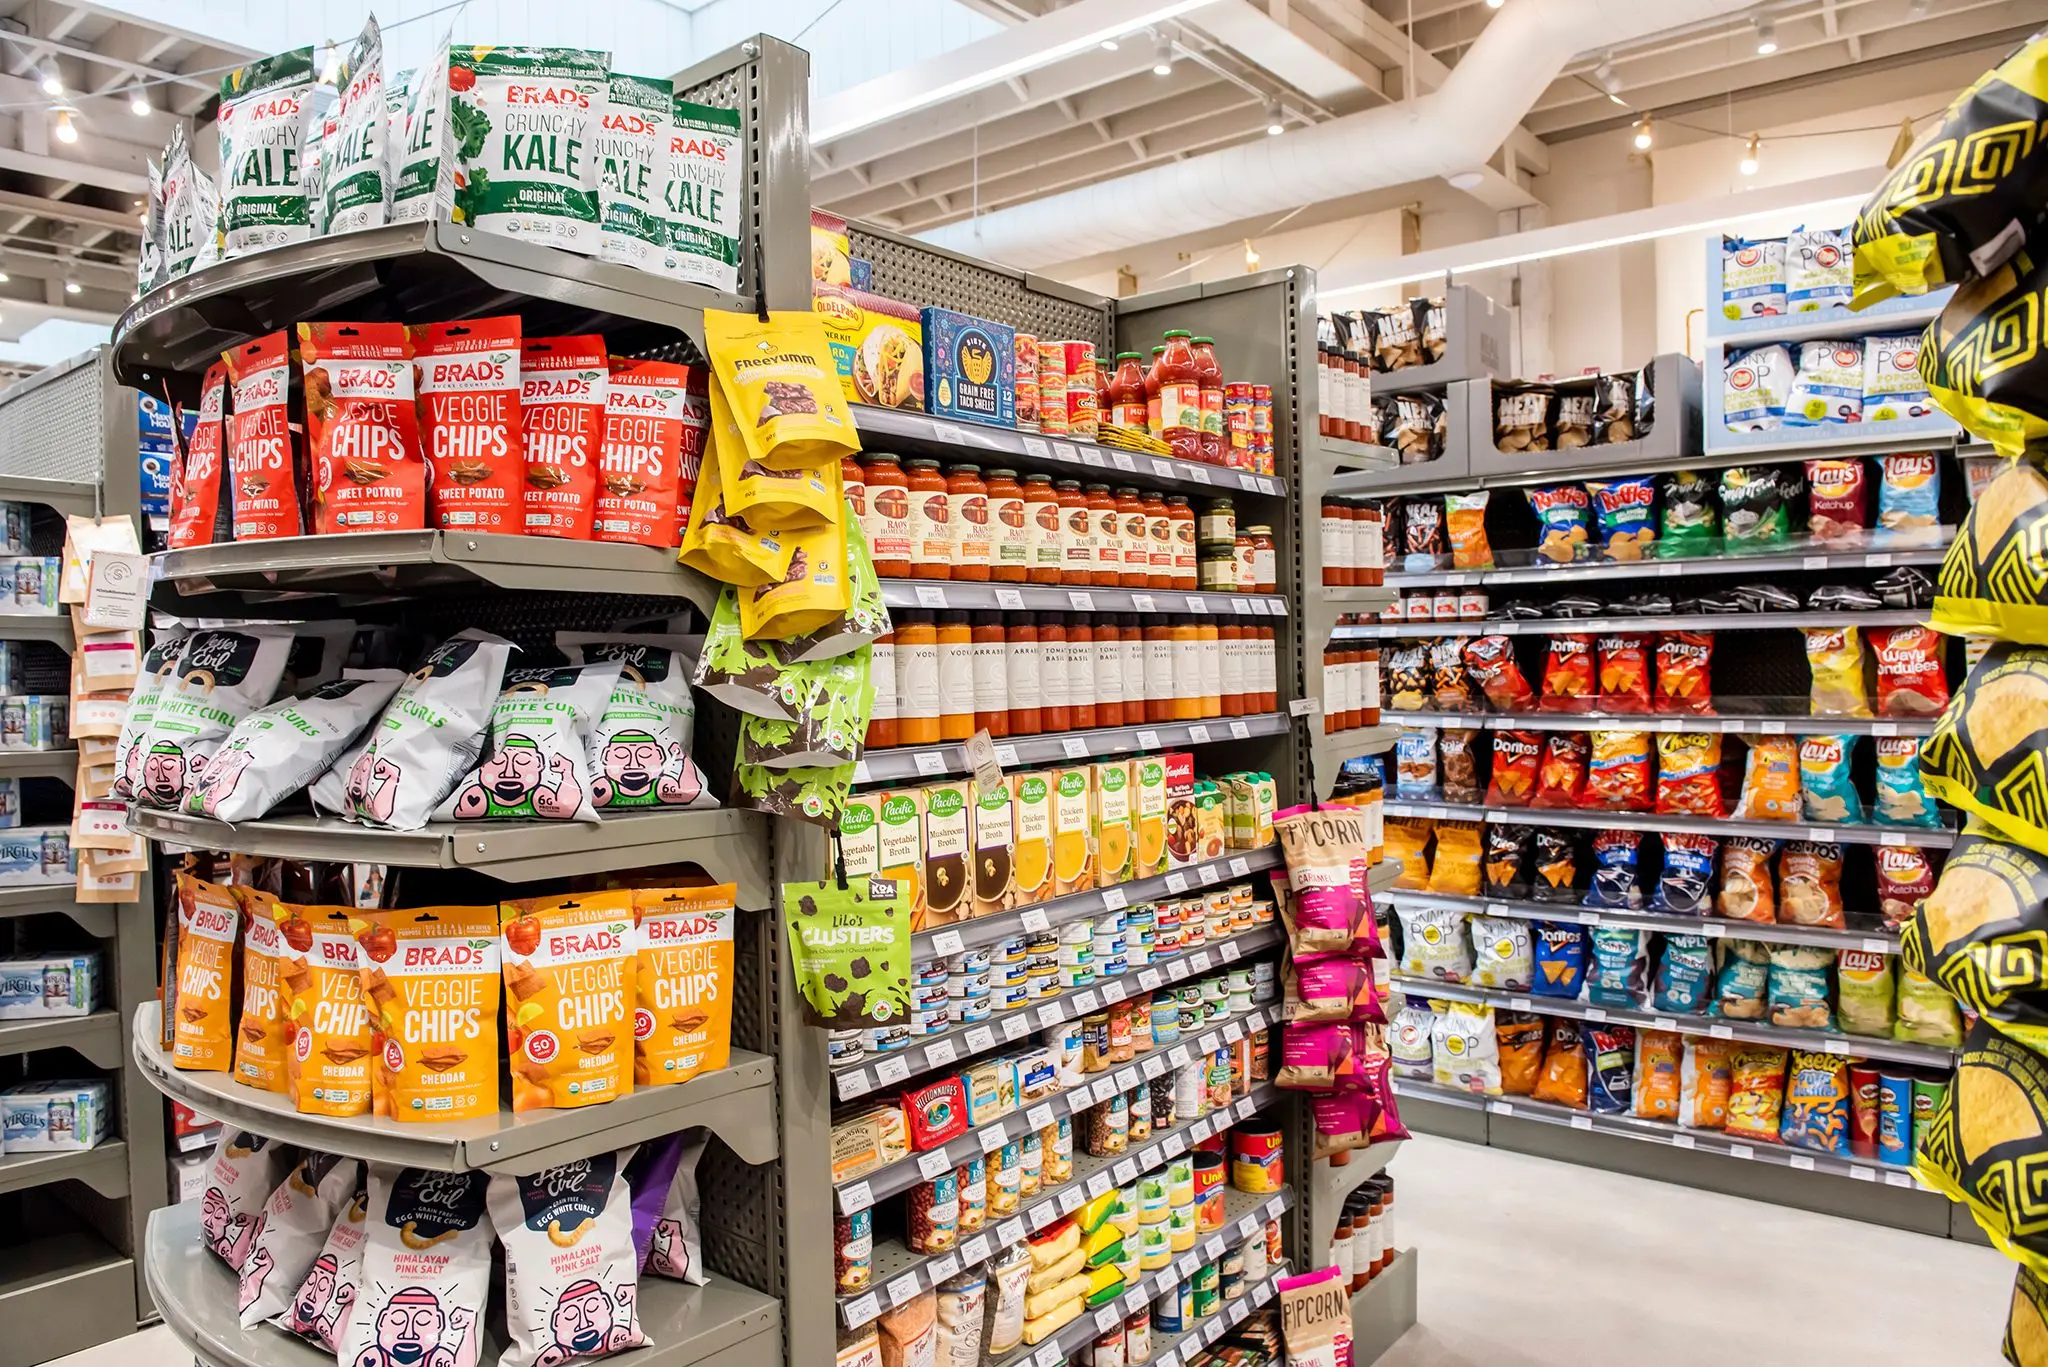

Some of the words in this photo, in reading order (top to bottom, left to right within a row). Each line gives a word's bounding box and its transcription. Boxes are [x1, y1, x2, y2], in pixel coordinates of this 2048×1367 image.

[504, 113, 587, 137] CRUNCHY
[504, 134, 582, 180] KALE
[519, 189, 566, 204] ORIGINAL
[236, 202, 279, 216] ORIGINAL
[959, 383, 979, 396] GRAIN
[980, 386, 995, 399] FREE
[1002, 390, 1013, 401] 12
[433, 396, 507, 422] VEGGIE
[959, 396, 975, 408] TACO
[975, 399, 995, 412] SHELLS
[241, 409, 283, 438] VEGGIE
[331, 425, 405, 460] CHIPS
[432, 425, 508, 459] CHIPS
[236, 438, 283, 473] CHIPS
[1888, 455, 1935, 478] Lay's
[337, 487, 364, 500] SWEET
[366, 486, 403, 498] POTATO
[438, 488, 465, 500] SWEET
[468, 487, 505, 499] POTATO
[546, 492, 581, 504] POTATO
[1533, 486, 1589, 511] Ruffles
[1600, 483, 1654, 511] Ruffles
[253, 498, 280, 511] POTATO
[627, 499, 657, 513] POTATO
[1815, 500, 1854, 511] Ketchup
[608, 647, 646, 668] Evil
[1882, 650, 1926, 663] Wavy
[403, 700, 448, 728] CURLS
[649, 701, 694, 717] CURLS
[200, 707, 237, 728] CURL
[1493, 738, 1539, 756] Doritos
[1060, 776, 1084, 791] Pacific
[1102, 771, 1125, 786] Pacific
[662, 784, 677, 794] 6G
[1022, 782, 1046, 797] Pacific
[538, 796, 554, 806] 6G
[931, 794, 961, 809] Pacific
[1104, 799, 1125, 809] Chicken
[884, 802, 914, 817] Pacific
[1060, 807, 1084, 817] Chicken
[840, 811, 872, 826] Pacific
[979, 819, 1011, 832] Mushroom
[1021, 814, 1046, 824] Chicken
[1063, 815, 1081, 825] Broth
[929, 827, 965, 839] Mushroom
[985, 829, 1004, 840] Broth
[1025, 822, 1043, 832] Broth
[882, 834, 918, 847] Vegetable
[937, 836, 957, 848] Broth
[842, 844, 876, 857] egetable
[889, 846, 911, 857] Broth
[843, 856, 868, 867] Broth
[1882, 848, 1923, 872] Lay's
[871, 884, 894, 895] KOA
[1887, 884, 1929, 894] Ketchup
[801, 926, 896, 946] CLUSTERS
[1483, 933, 1528, 959] POP
[190, 940, 224, 969] VEGGIE
[651, 946, 718, 975] VEGGIE
[1841, 949, 1884, 971] Lay's
[182, 964, 221, 1001] CHIPS
[553, 961, 624, 996] VEGGIE
[404, 978, 483, 1008] VEGGIE
[654, 972, 719, 1010] CHIPS
[313, 1000, 371, 1037] CHIP
[557, 990, 625, 1032] CHIPS
[179, 1023, 204, 1037] CHEDDAR
[404, 1007, 481, 1043] CHIPS
[672, 1030, 707, 1048] CHEDDAR
[1436, 1033, 1479, 1057] POP
[532, 1039, 552, 1055] 50
[578, 1053, 615, 1069] CHEDDAR
[322, 1065, 365, 1078] CHEDDAR
[420, 1071, 467, 1086] CHEDDAR
[548, 1173, 584, 1197] Evil
[419, 1180, 465, 1209] Evil
[395, 1213, 413, 1224] EGG
[415, 1212, 442, 1224] WHITE
[444, 1217, 467, 1227] CURLS
[536, 1212, 554, 1228] EGG
[553, 1204, 574, 1217] WHITE
[574, 1204, 596, 1216] CURLS
[393, 1254, 449, 1265] HIMALAYAN
[550, 1244, 603, 1266] HIMALAYAN
[395, 1264, 418, 1274] PINK
[420, 1264, 444, 1275] SALT
[555, 1260, 579, 1275] PINK
[580, 1255, 601, 1269] SALT
[1283, 1288, 1344, 1331] PIPCORN
[613, 1333, 627, 1344] 6G
